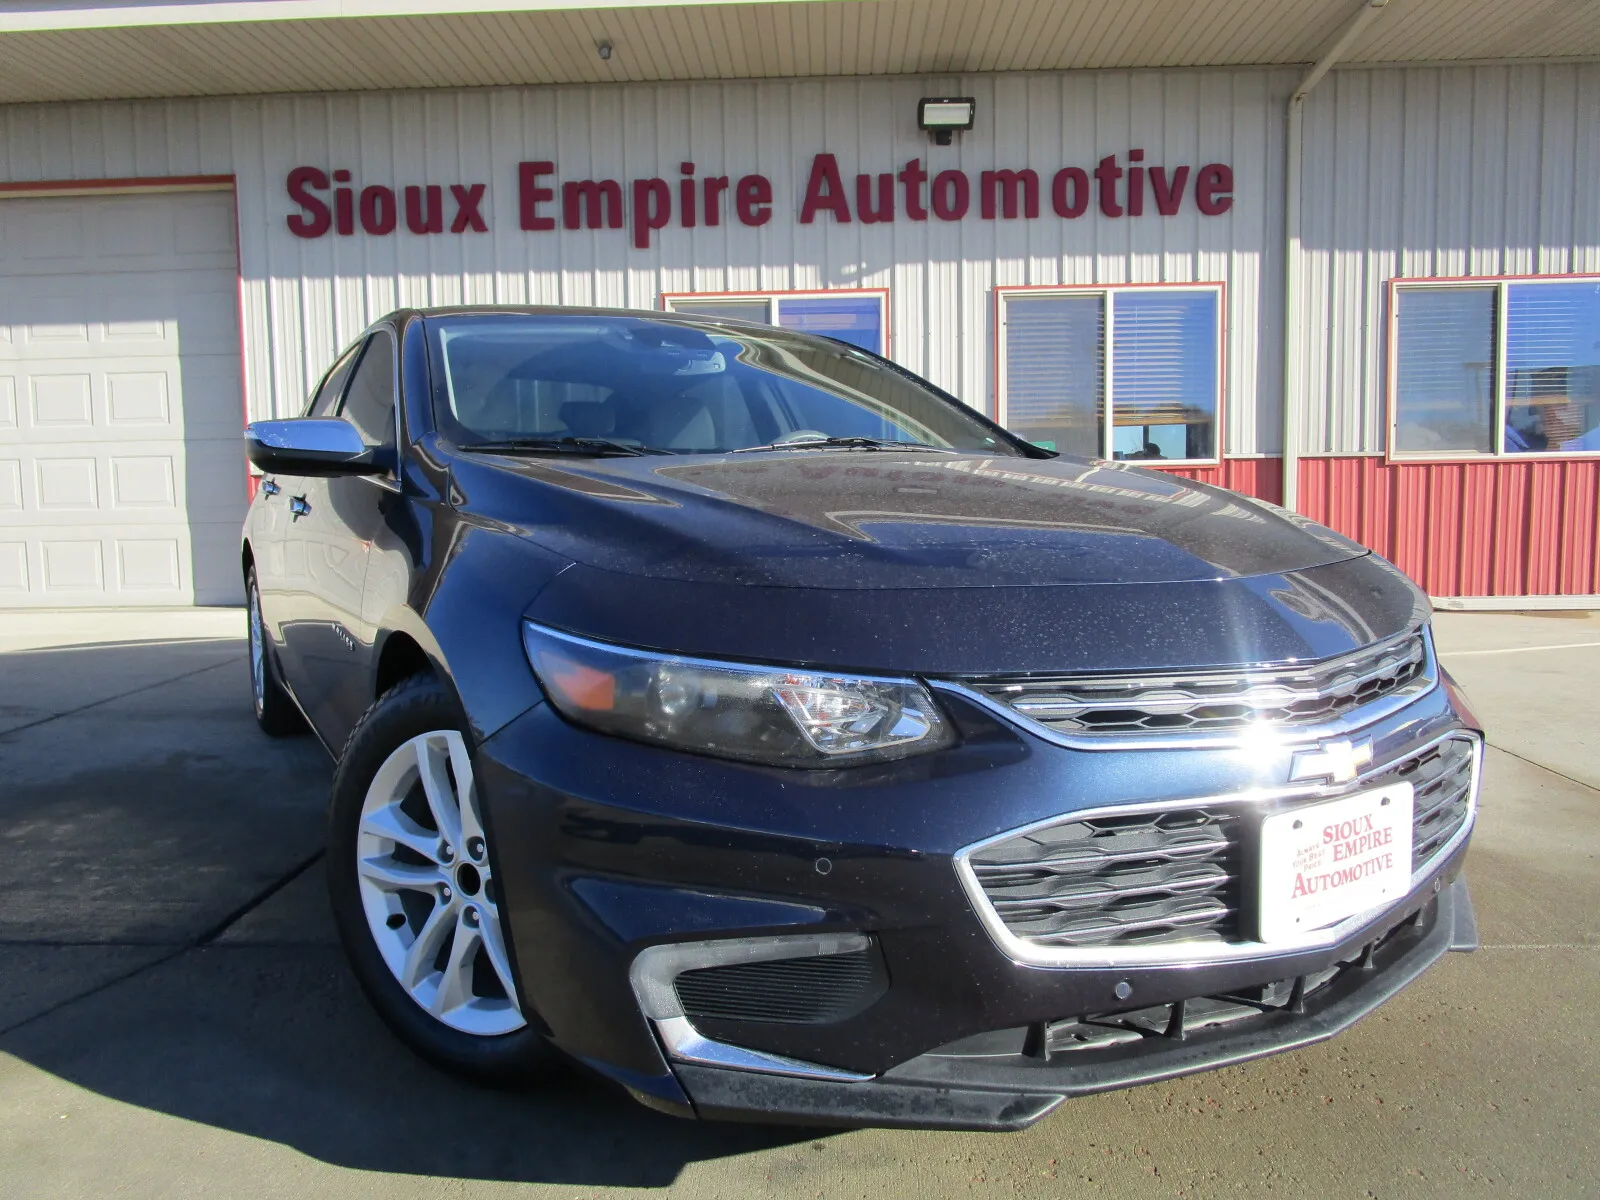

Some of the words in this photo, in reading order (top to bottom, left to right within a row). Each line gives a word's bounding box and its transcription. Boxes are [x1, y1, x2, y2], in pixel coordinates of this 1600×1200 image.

[286, 165, 488, 238] Sioux
[518, 161, 773, 248] Empire
[800, 149, 1234, 223] Automotive
[1323, 814, 1373, 844] SIOUX
[1333, 827, 1392, 862] EMPIRE
[1291, 853, 1393, 899] AUTOMOTIVE
